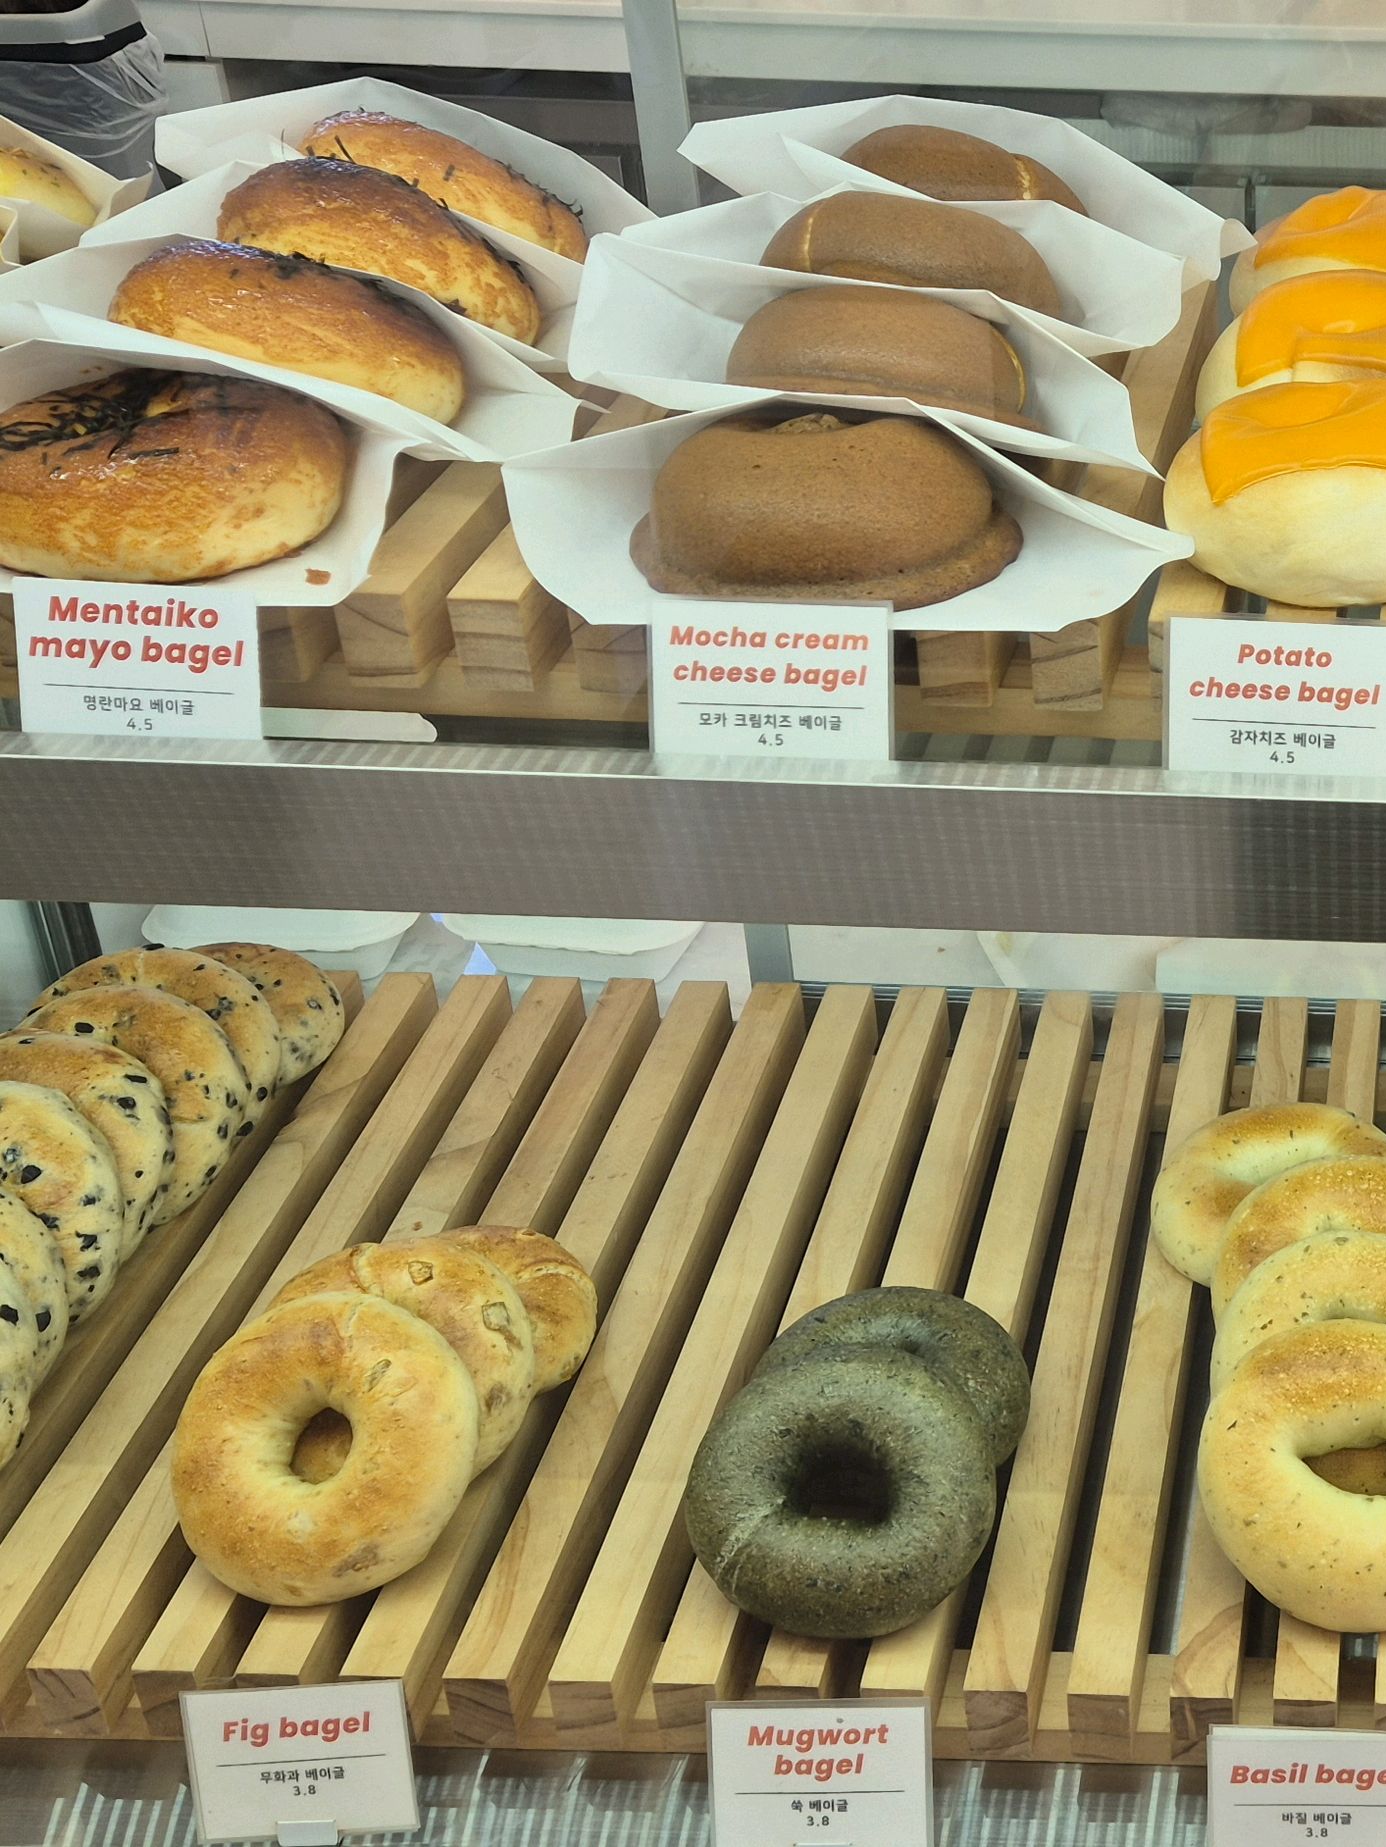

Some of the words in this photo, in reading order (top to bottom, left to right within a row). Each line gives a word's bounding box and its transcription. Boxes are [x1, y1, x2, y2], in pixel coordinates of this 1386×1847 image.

[50, 597, 219, 629] Mentaiko
[671, 627, 768, 649] Mocha
[776, 633, 869, 650] cream
[30, 637, 132, 668] mayo
[142, 637, 244, 674] bagel
[1239, 644, 1332, 669] Potato
[674, 662, 777, 684] cheese
[784, 665, 868, 693] bagel
[1189, 677, 1291, 701] cheese
[1298, 683, 1380, 712] bagel
[84, 696, 143, 711] 명란마요
[150, 699, 194, 715] 베이글
[127, 718, 152, 730] 4.5
[700, 713, 727, 727] 모카
[734, 714, 792, 728] 크림치즈
[799, 715, 841, 731] 베이글
[758, 734, 783, 746] 4.5
[1230, 730, 1287, 745] 감자치즈
[1294, 733, 1335, 749] 베이글
[1270, 751, 1294, 763] 4.5
[224, 1719, 271, 1748] Fig
[280, 1712, 371, 1743] bagel
[748, 1725, 889, 1755] Mugwort
[261, 1770, 299, 1784] 무화과
[305, 1767, 344, 1780] 베이글
[774, 1752, 864, 1782] bagel
[1232, 1764, 1309, 1785] Basil
[293, 1785, 316, 1796] 3.8
[809, 1799, 848, 1812] 베이글
[807, 1816, 829, 1826] 3.8
[1282, 1813, 1306, 1824] 바질
[1313, 1813, 1351, 1824] 베이글
[1306, 1828, 1327, 1837] 3.8
